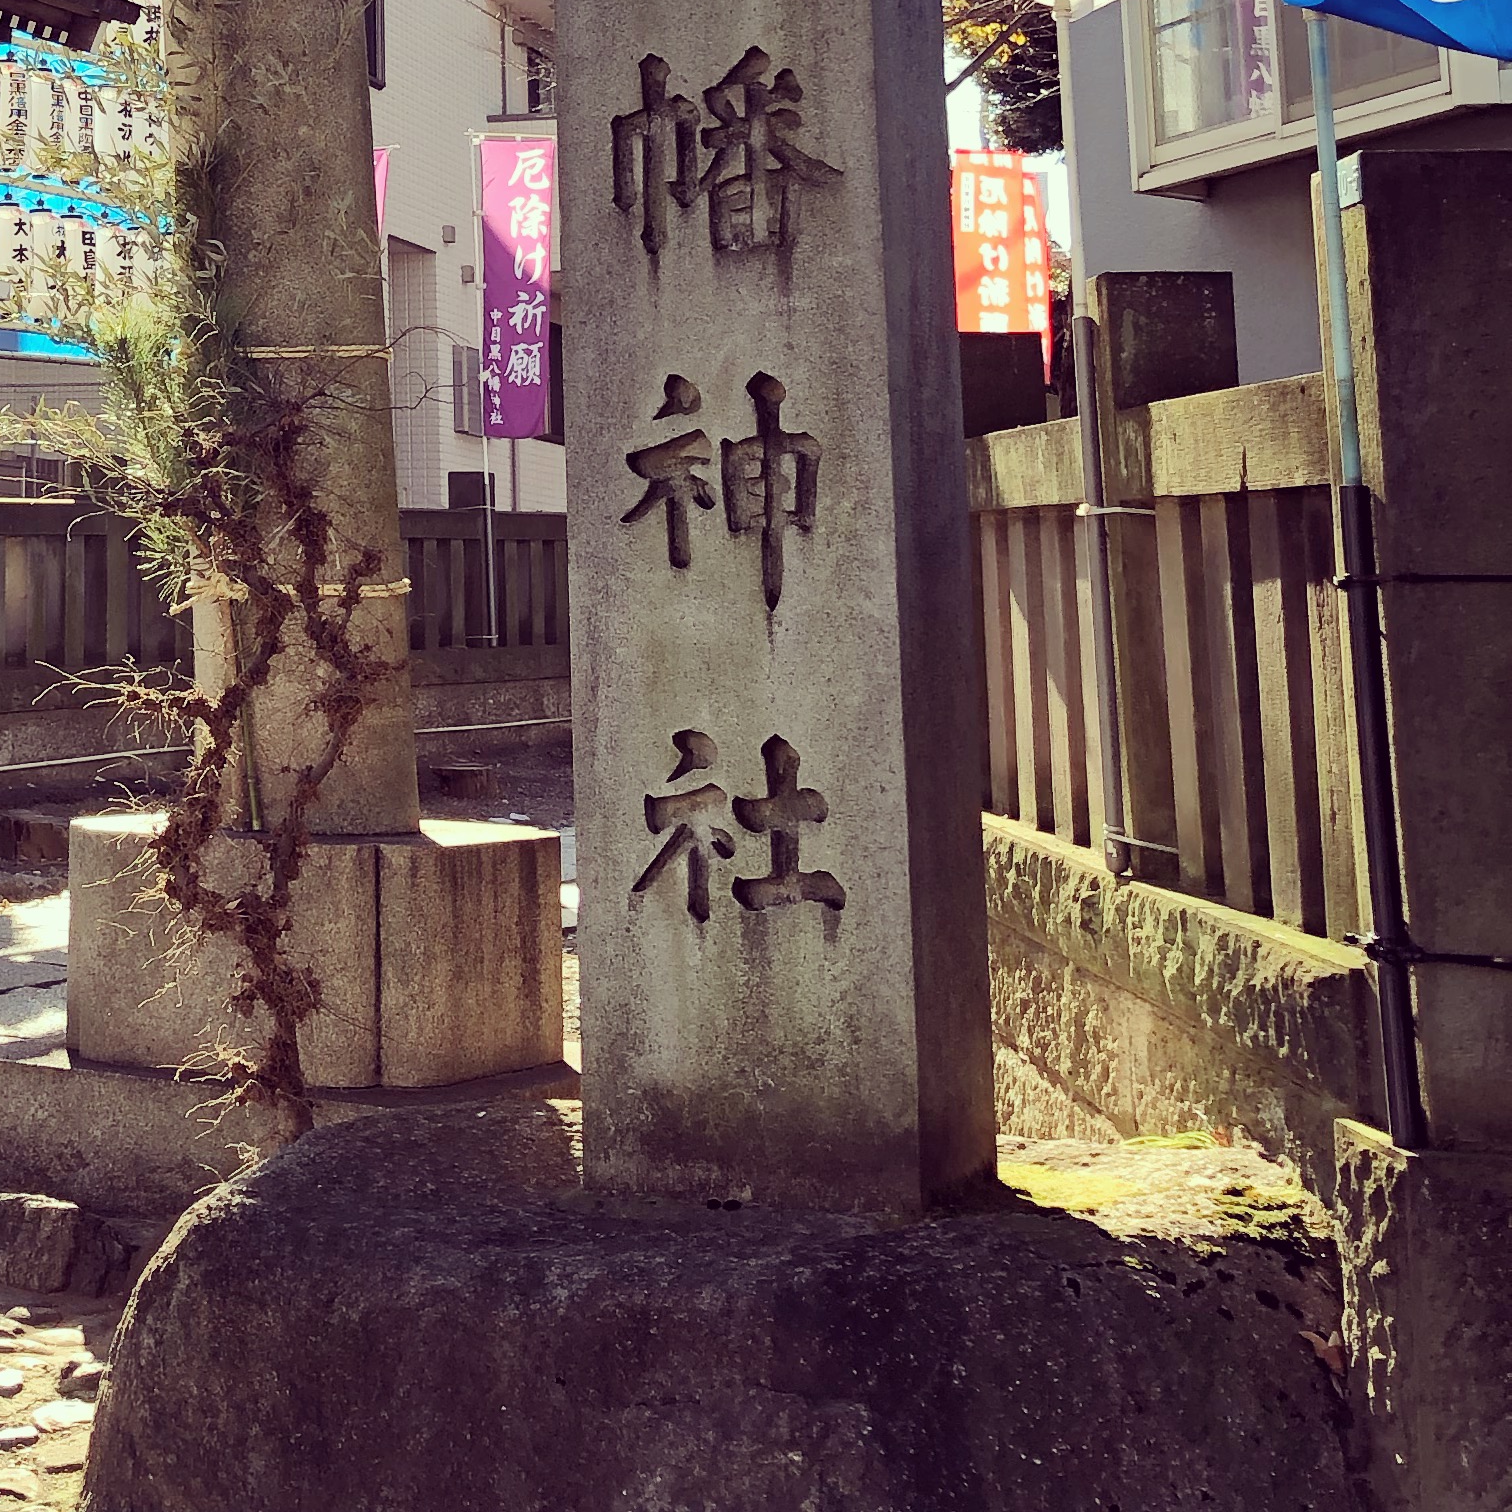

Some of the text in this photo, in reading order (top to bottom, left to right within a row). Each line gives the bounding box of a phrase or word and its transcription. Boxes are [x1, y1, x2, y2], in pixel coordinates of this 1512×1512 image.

[504, 148, 552, 387] 厄除け祈願
